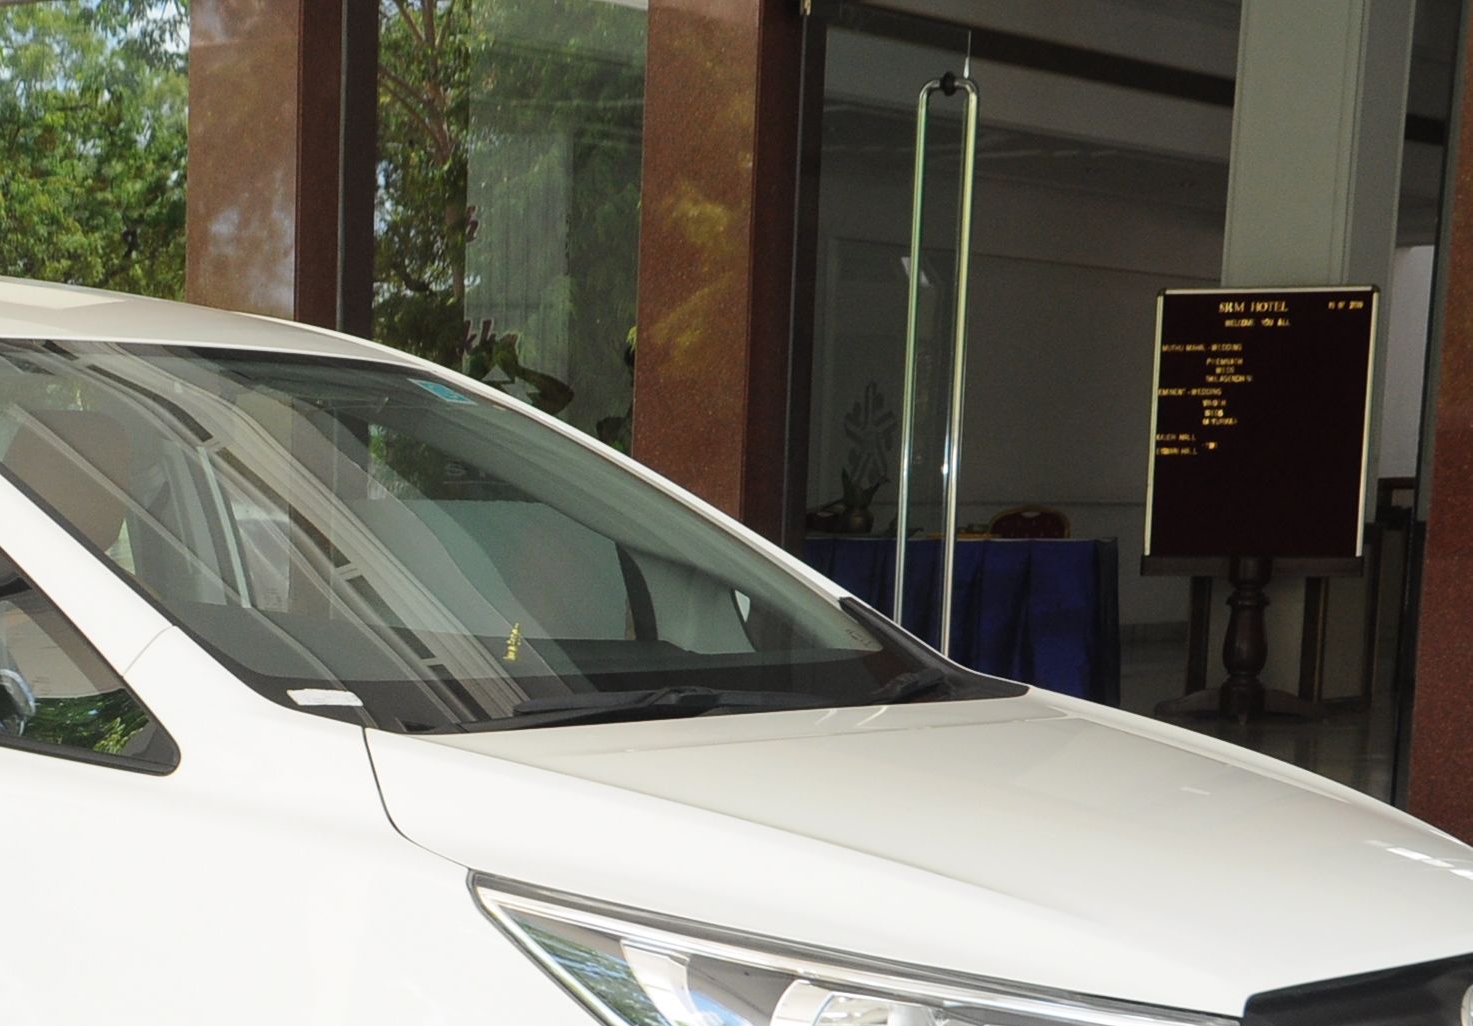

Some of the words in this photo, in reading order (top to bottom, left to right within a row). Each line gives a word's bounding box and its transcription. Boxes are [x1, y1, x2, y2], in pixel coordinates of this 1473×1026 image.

[1218, 301, 1245, 313] SRM
[1250, 300, 1288, 312] HOTEL
[1277, 317, 1290, 326] ALL
